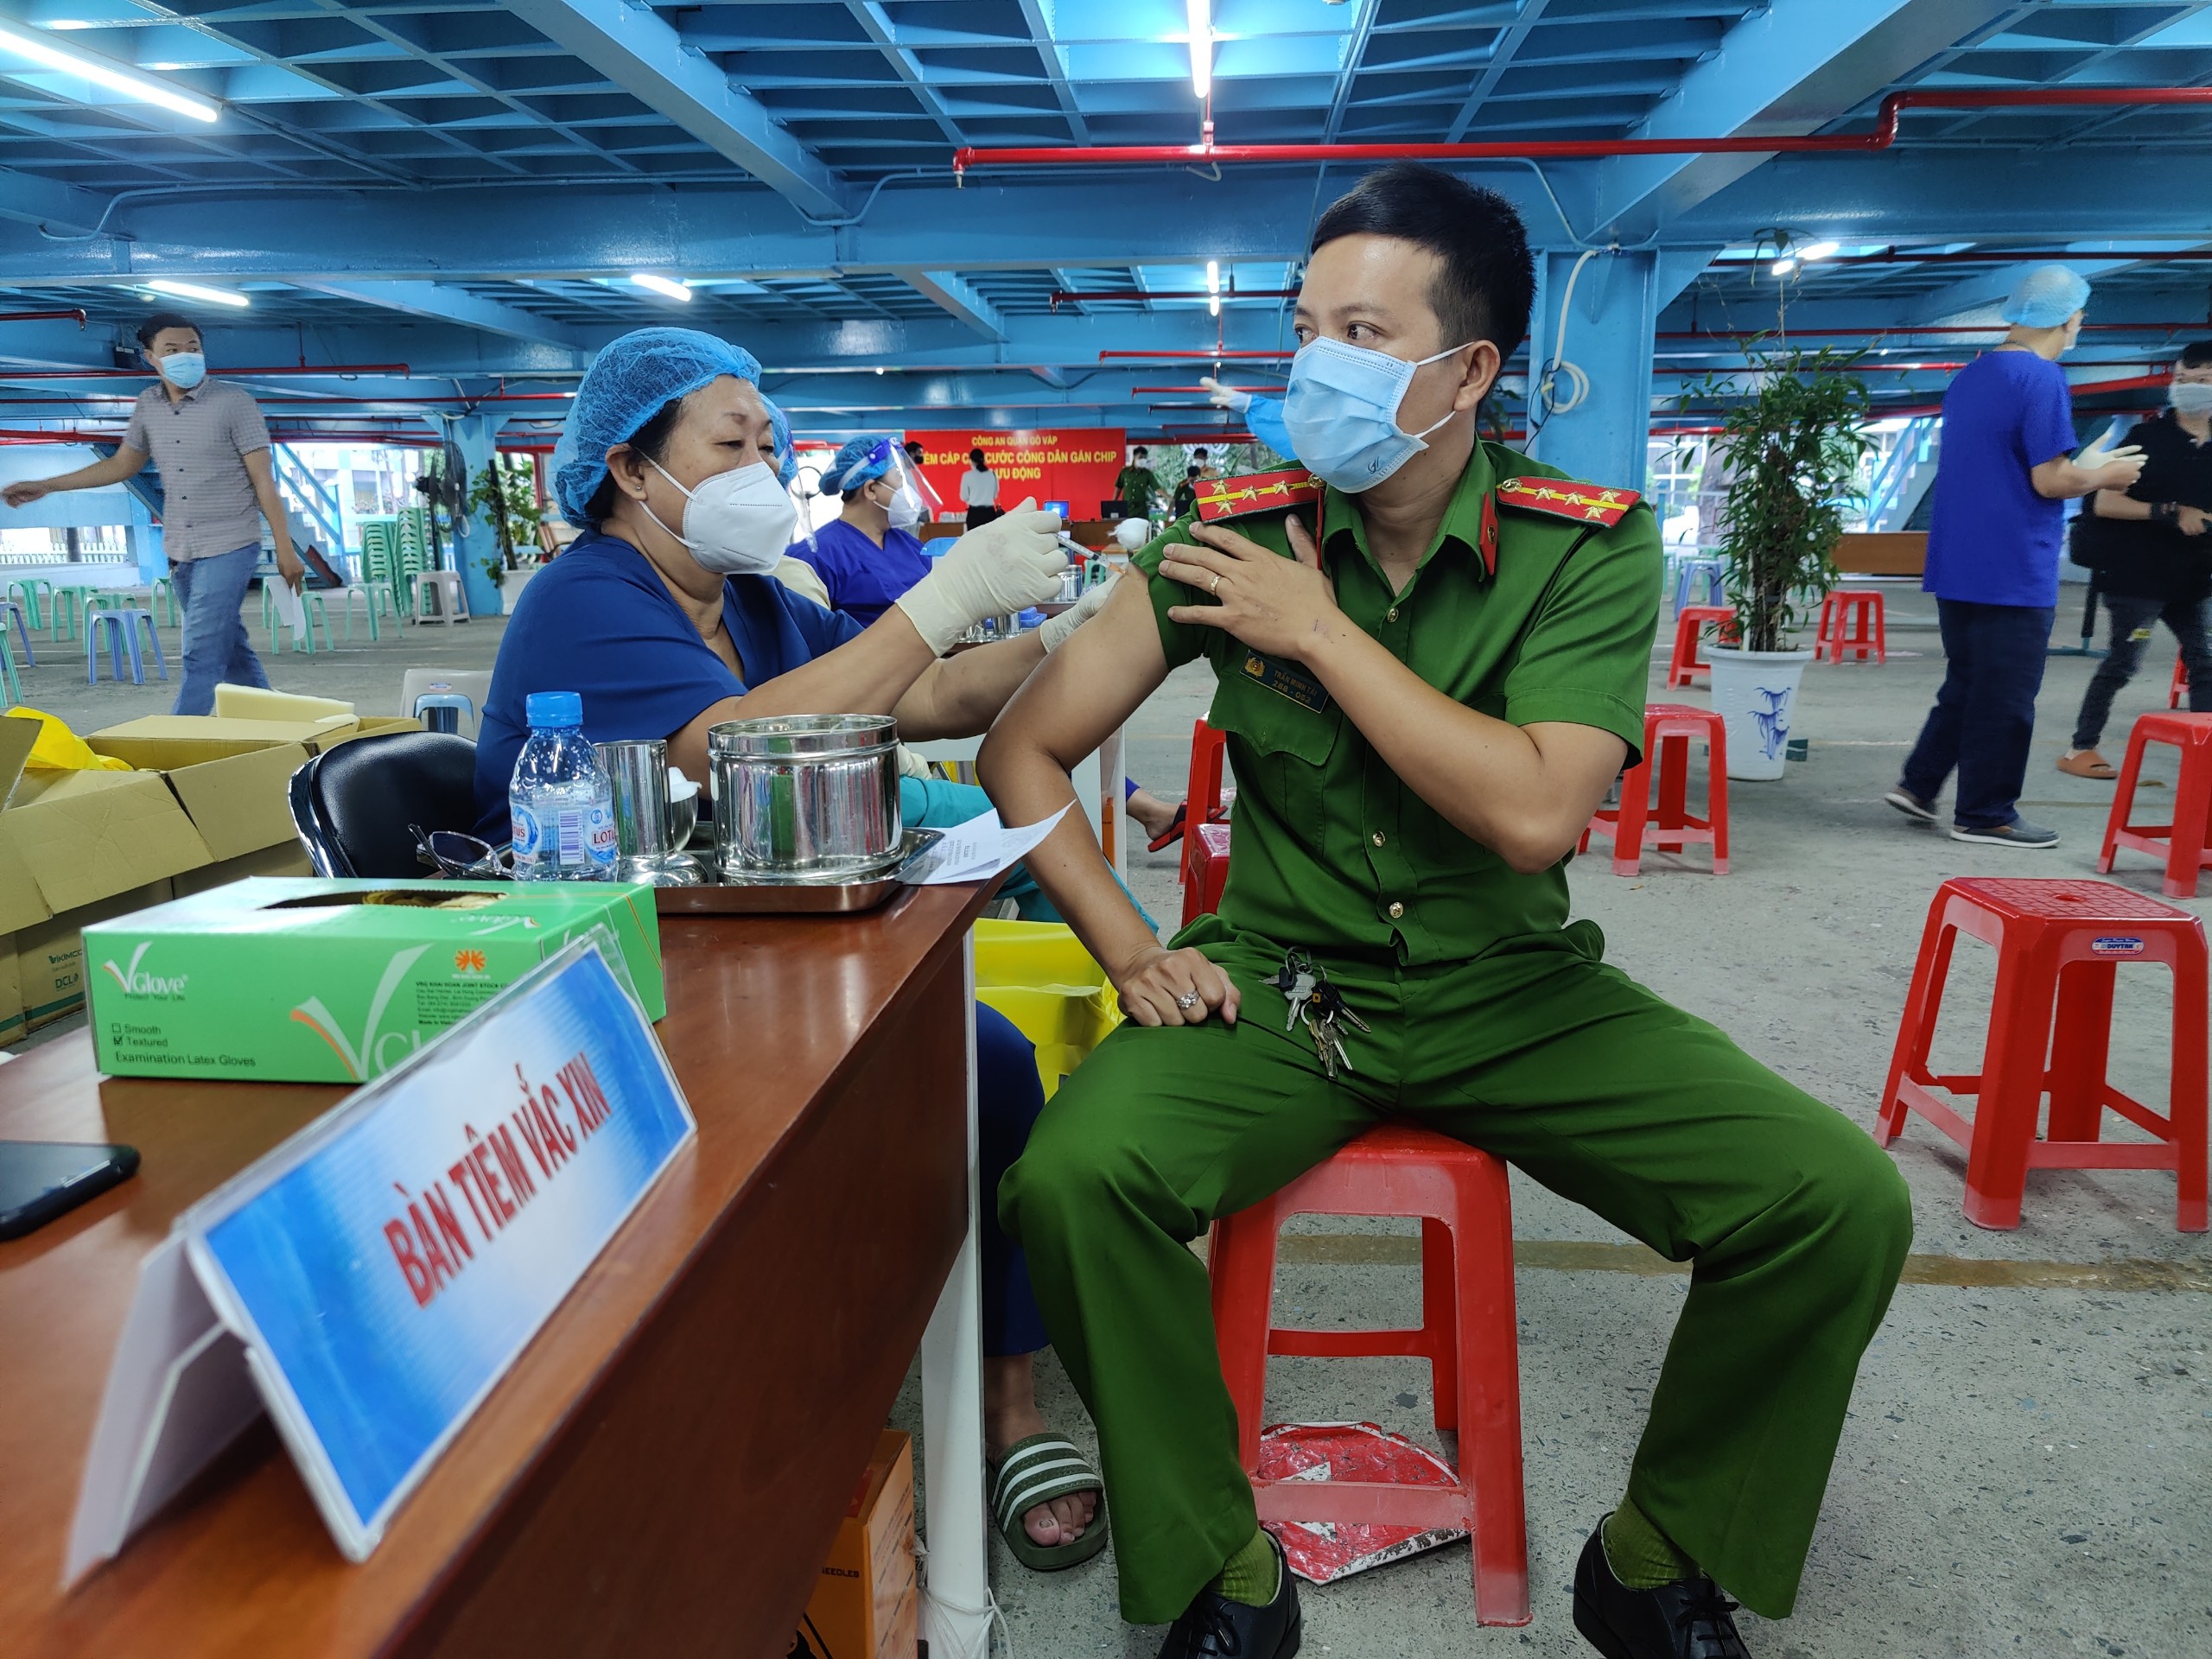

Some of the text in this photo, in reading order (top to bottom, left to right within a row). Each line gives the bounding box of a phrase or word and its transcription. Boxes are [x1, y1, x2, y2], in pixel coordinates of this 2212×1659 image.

[971, 435, 994, 447] CÔNG
[995, 436, 1006, 446] AN
[939, 451, 961, 465] CẤP
[1016, 449, 1046, 464] CÔNG
[1047, 448, 1069, 464] DÂN
[1094, 450, 1117, 463] CHIP
[995, 467, 1042, 481] ƯU ĐỘNG
[512, 826, 525, 838] TUS
[593, 828, 614, 844] LOT
[55, 975, 73, 988] DCL
[124, 1024, 162, 1035] Smooth
[127, 1036, 168, 1047] Textured
[116, 1051, 257, 1067] Examination Latex Gloves
[383, 1051, 613, 1309] BÀN TIÊM VẮC XIN
